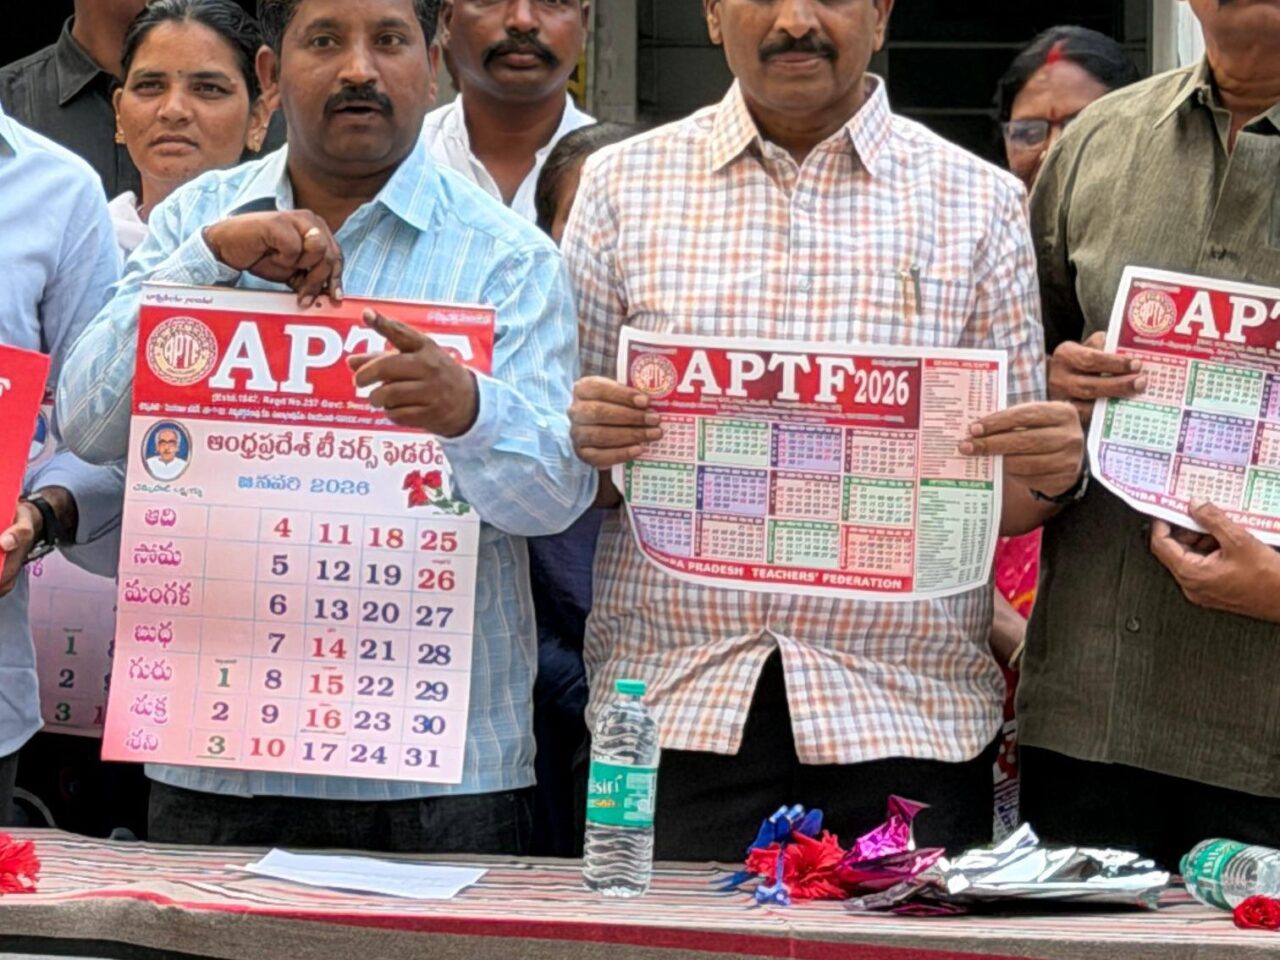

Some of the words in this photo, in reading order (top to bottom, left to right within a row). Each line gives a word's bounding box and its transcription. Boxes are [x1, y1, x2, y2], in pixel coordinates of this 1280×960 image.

[1173, 290, 1280, 343] AP
[163, 334, 200, 370] APTF
[676, 349, 857, 403] APTF
[854, 368, 910, 406] 2026
[206, 430, 311, 460] ఆంధ్రప్రదేశ్
[382, 439, 444, 467] ఫెడరే
[310, 476, 371, 495] 2026
[144, 506, 177, 527] ఆది
[273, 517, 292, 538] 4
[320, 523, 352, 545] 11
[369, 526, 404, 549] 18
[420, 529, 458, 553] 25
[133, 540, 182, 568] సోమ
[271, 554, 289, 577] 5
[315, 559, 351, 582] 12
[365, 563, 401, 587] 19
[417, 567, 455, 592] 26
[687, 561, 744, 577] PRADESH
[751, 567, 819, 582] TEACHERS'
[822, 573, 902, 589] FEDERATION
[124, 580, 192, 607] మంగళ
[269, 593, 287, 616] 6
[314, 597, 349, 620] 13
[361, 600, 400, 624] 20
[415, 605, 454, 628] 27
[65, 635, 78, 656] 1
[134, 620, 174, 647] బుధ
[268, 632, 286, 655] 7
[312, 636, 347, 659] 14
[360, 638, 396, 662] 21
[417, 643, 452, 667] 28
[58, 668, 75, 688] 2
[128, 656, 172, 682] గురు
[219, 667, 231, 688] 1
[264, 668, 283, 690] 8
[310, 673, 344, 696] 15
[357, 675, 394, 698] 22
[414, 680, 449, 703] 29
[54, 702, 72, 722] 3
[130, 693, 170, 724] శుక్ర
[210, 701, 230, 722] 2
[261, 703, 280, 725] 9
[306, 707, 342, 730] 16
[353, 710, 392, 734] 23
[411, 714, 446, 736] 30
[125, 729, 159, 753] శని
[206, 735, 226, 755] 3
[250, 737, 285, 758] 10
[302, 741, 338, 763] 17
[350, 744, 388, 765] 24
[403, 747, 441, 769] 31
